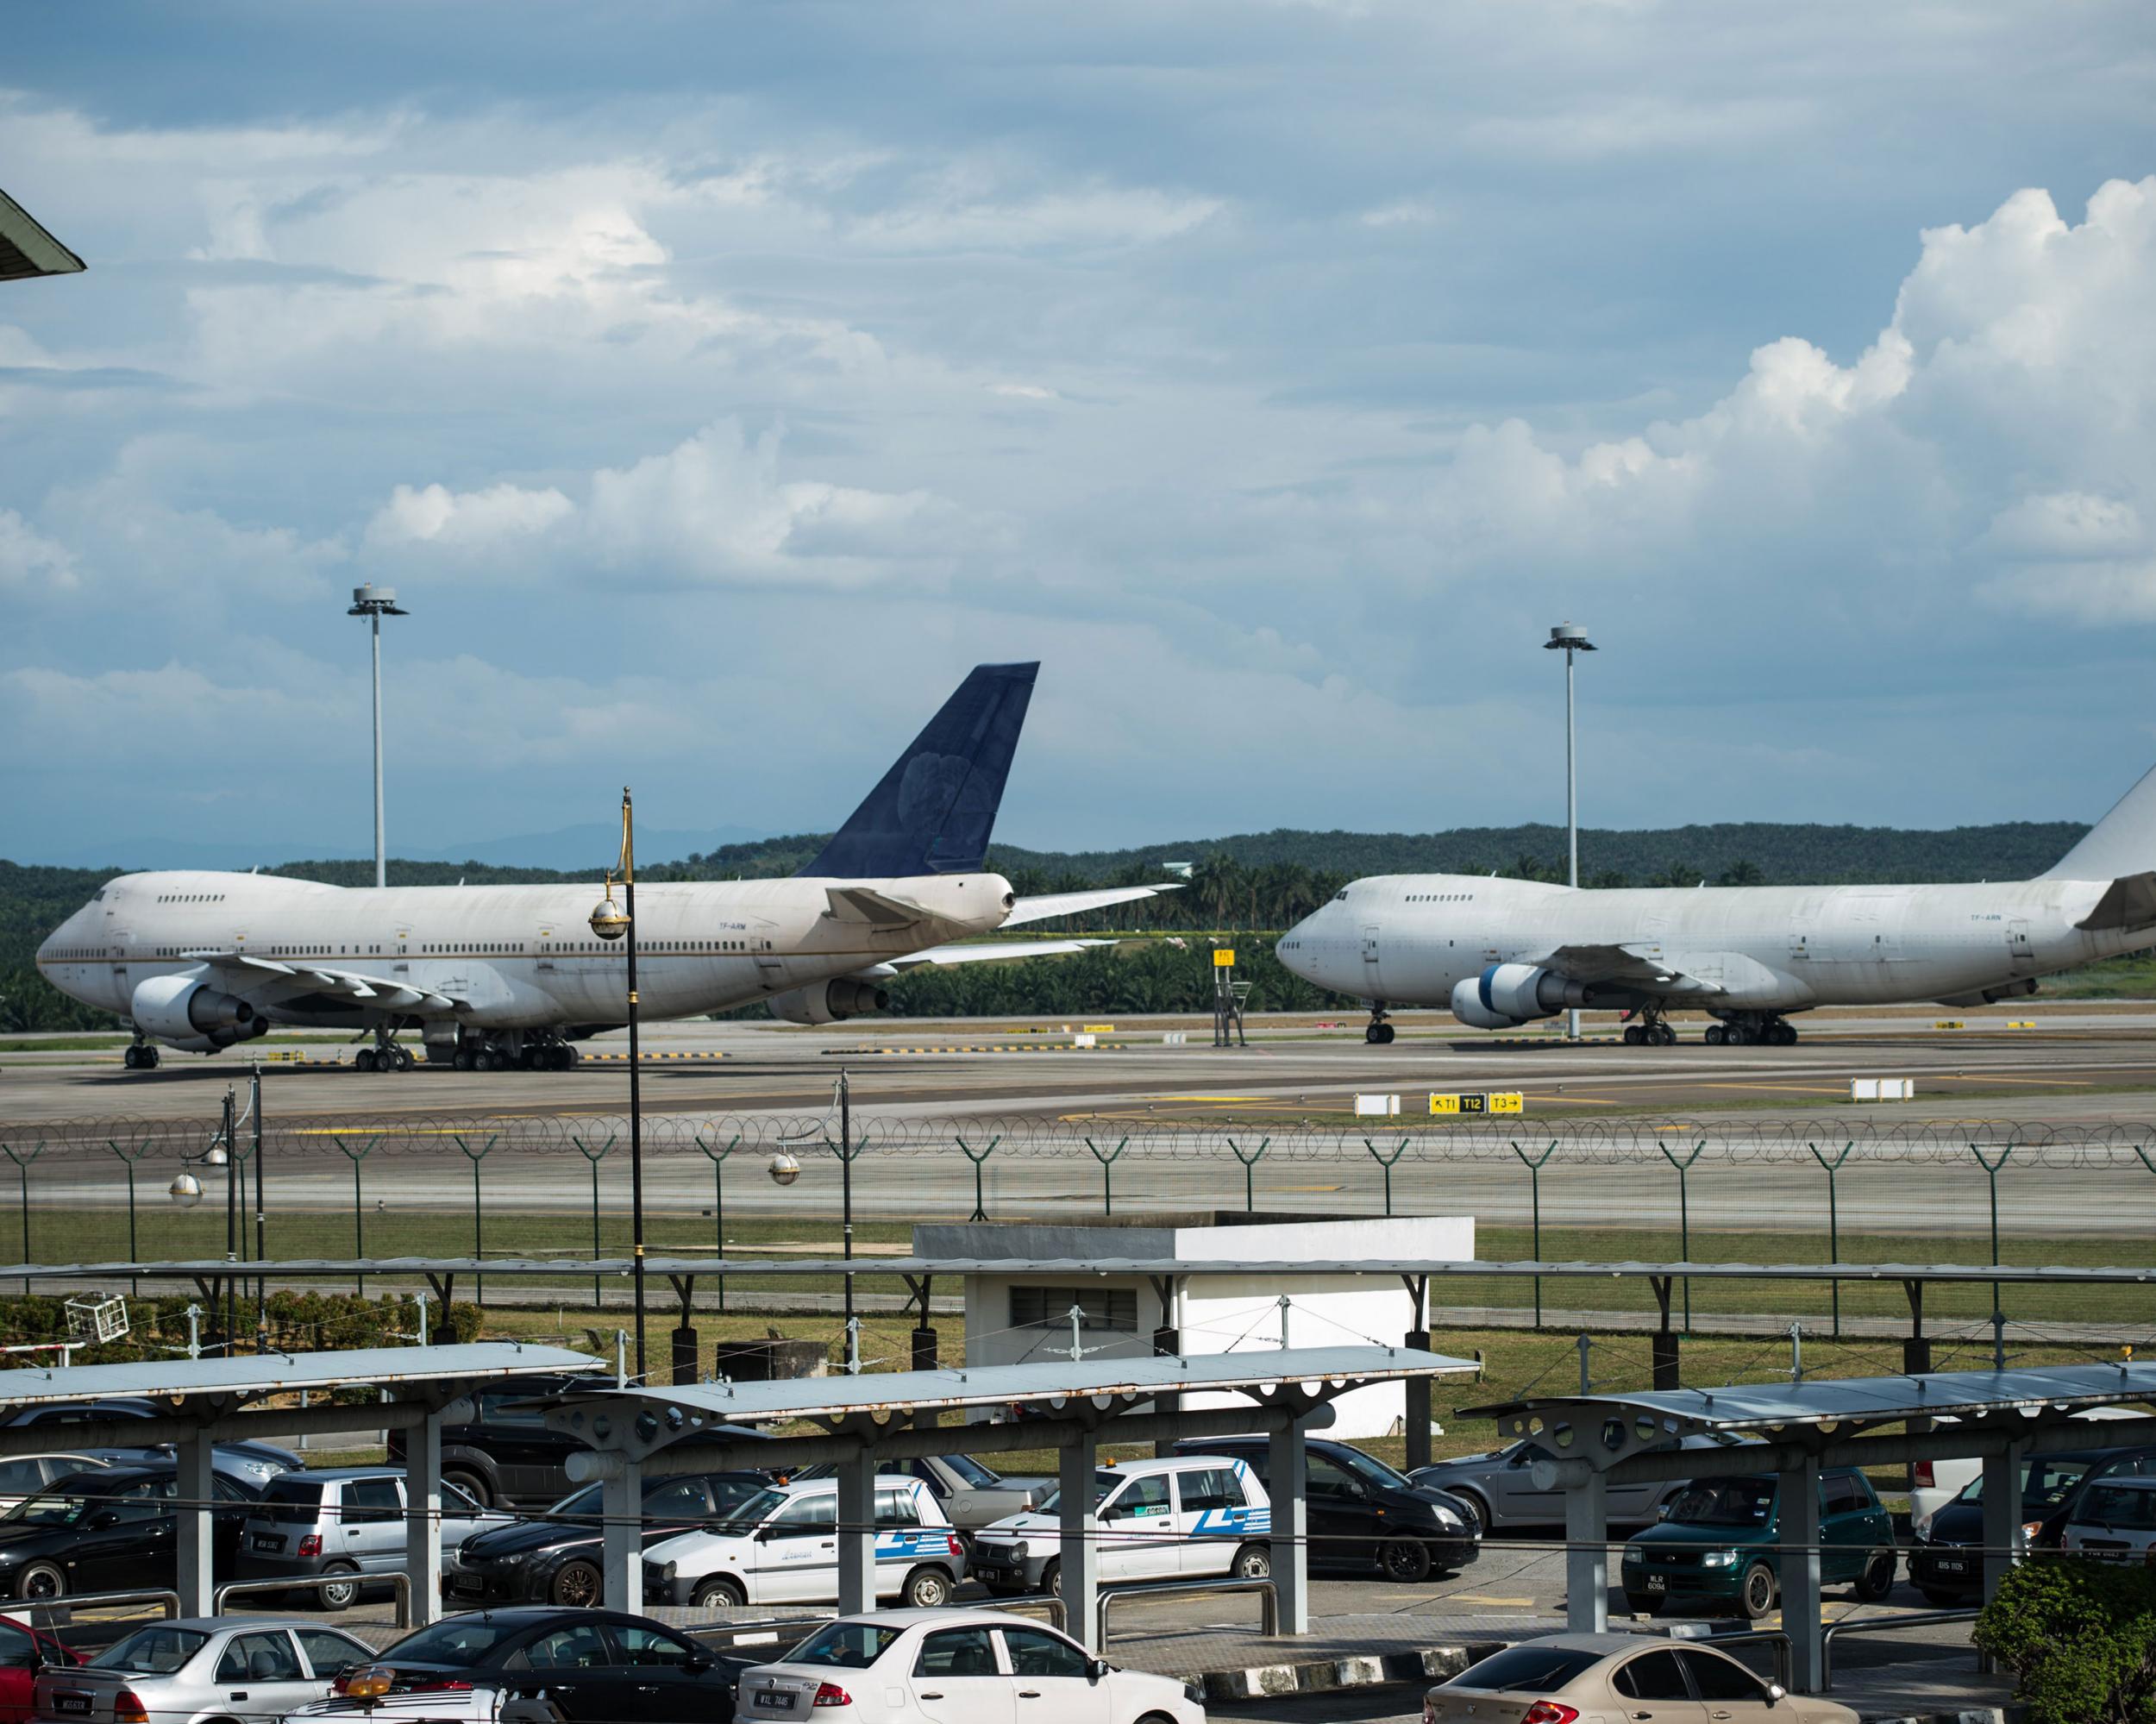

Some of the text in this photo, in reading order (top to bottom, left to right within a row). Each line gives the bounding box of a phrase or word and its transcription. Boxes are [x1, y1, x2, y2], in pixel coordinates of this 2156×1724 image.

[719, 922, 746, 931] TF-ARM
[1445, 1097, 1507, 1109] T1 T12 T3
[1938, 1560, 1964, 1571] AHS 1105
[1650, 1575, 1664, 1583] WLR
[1647, 1582, 1665, 1590] 6094
[760, 1695, 788, 1706] WXL 7446
